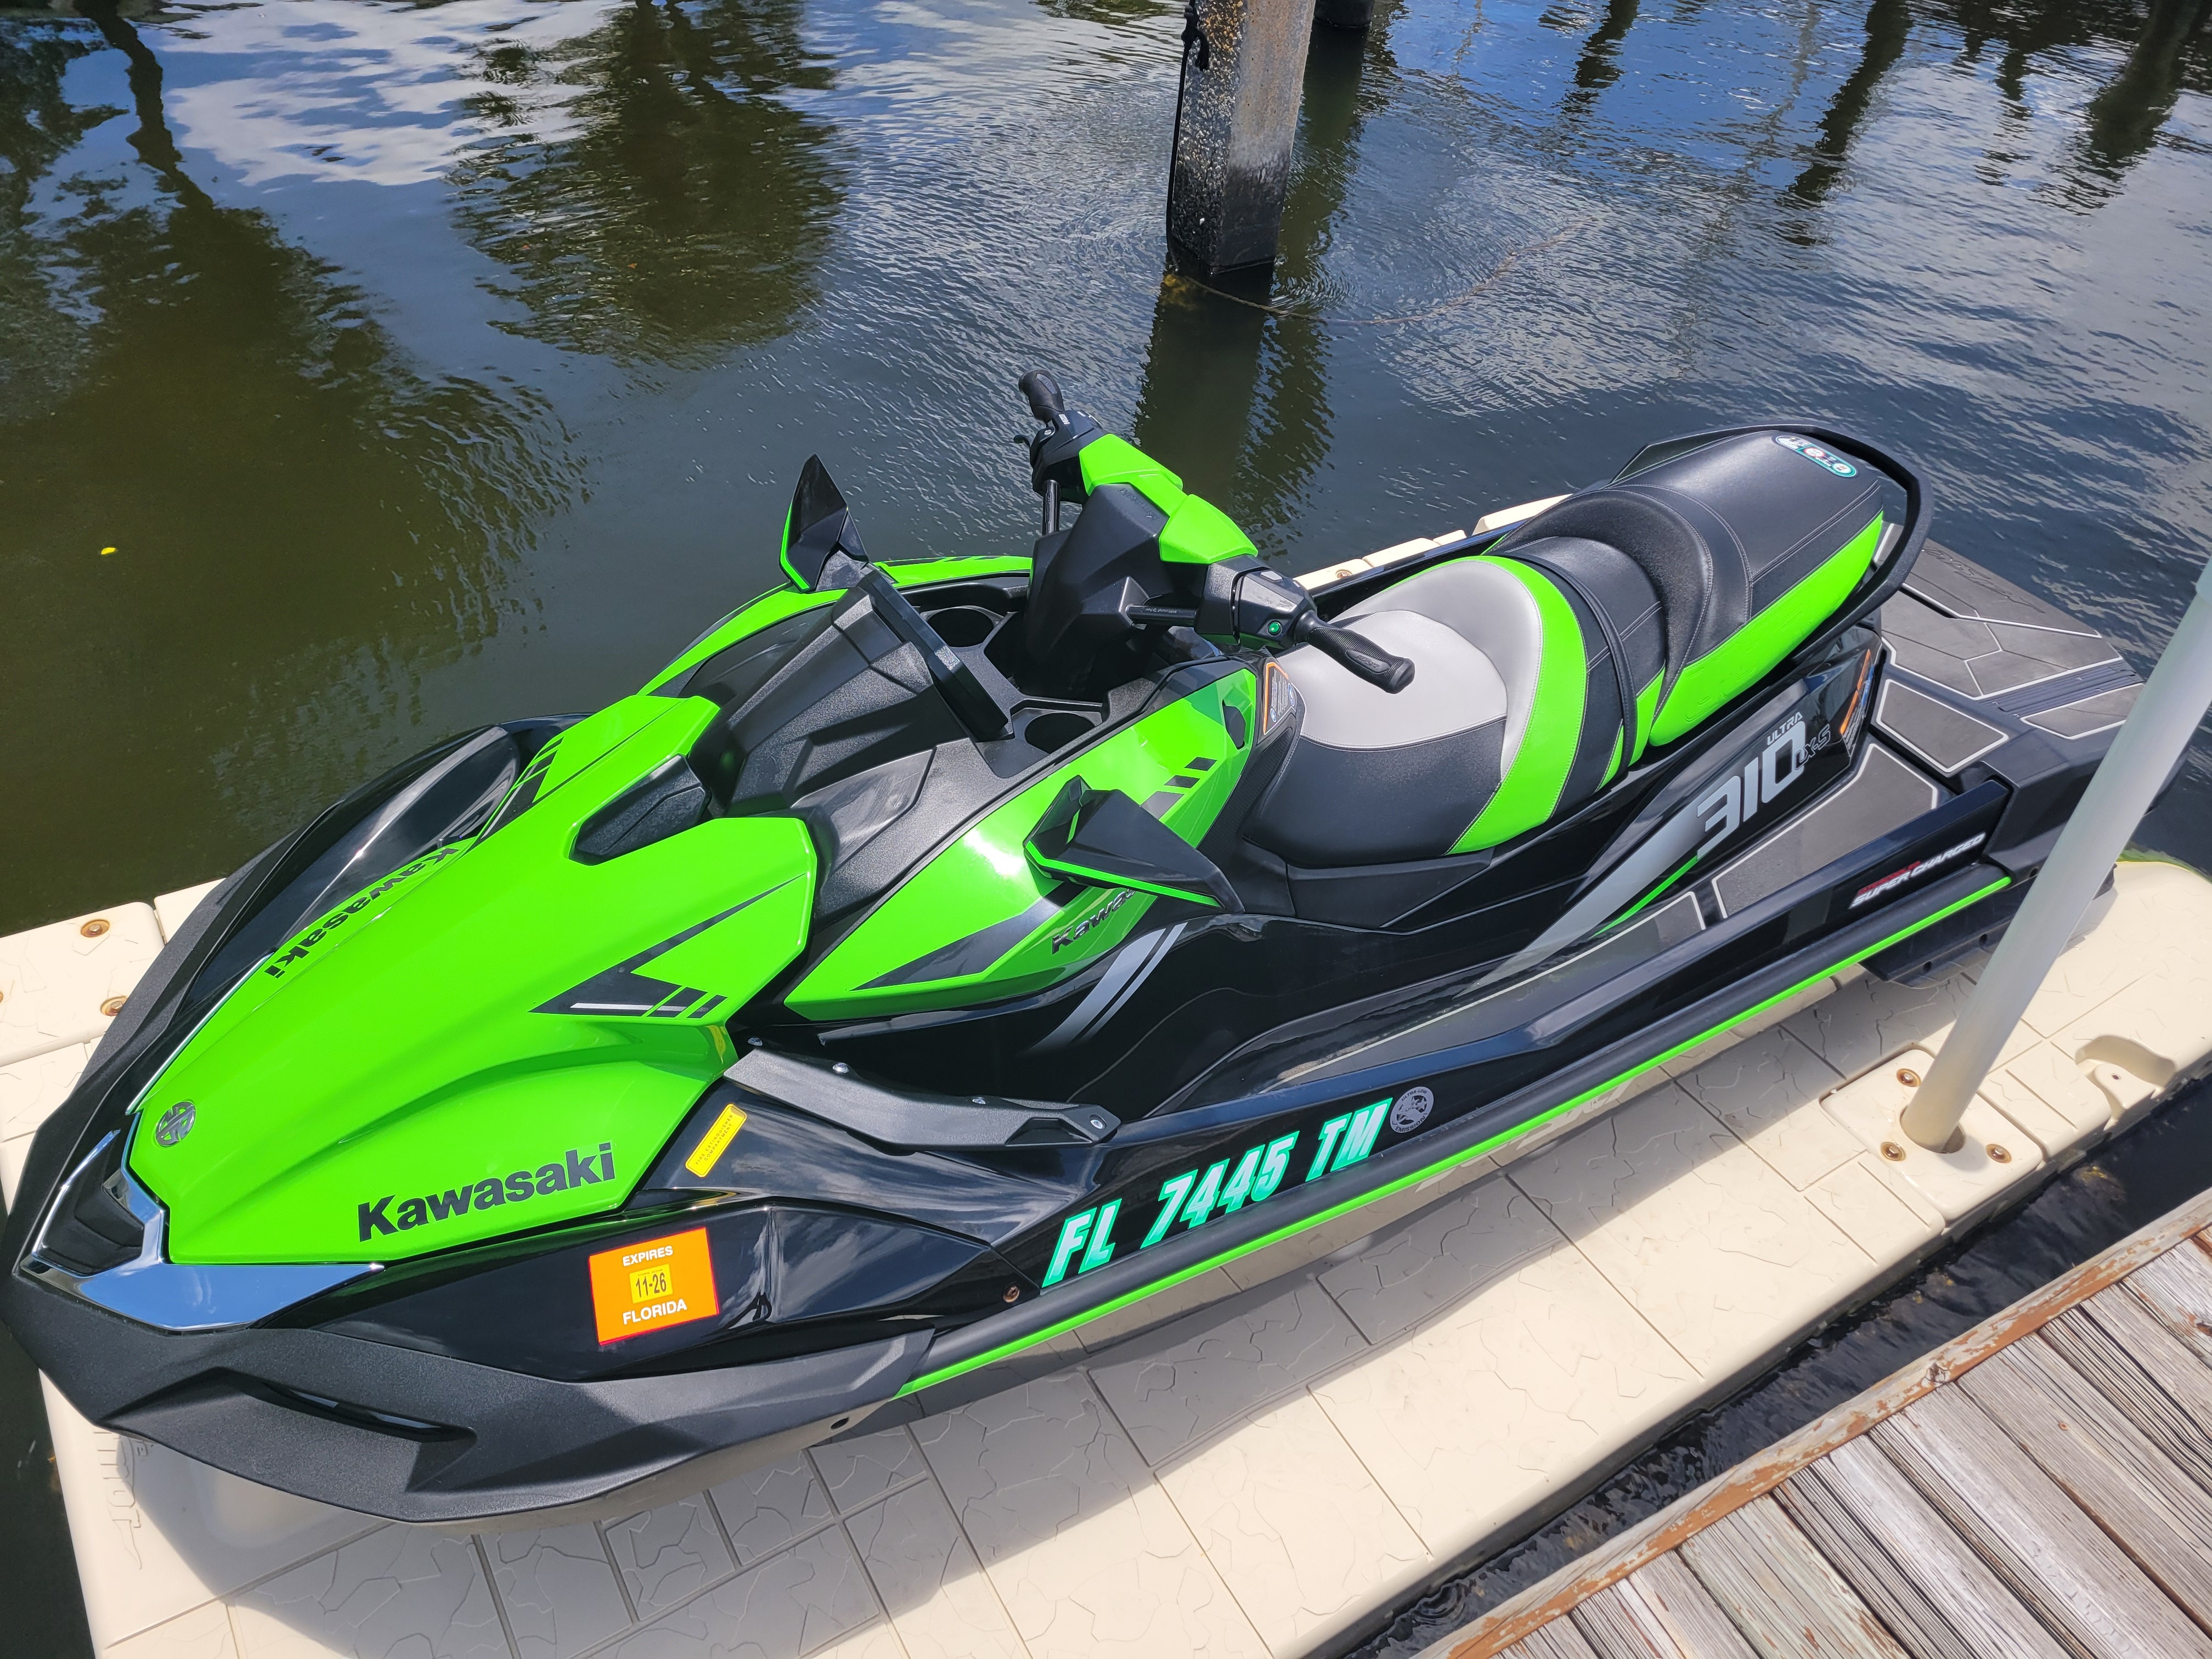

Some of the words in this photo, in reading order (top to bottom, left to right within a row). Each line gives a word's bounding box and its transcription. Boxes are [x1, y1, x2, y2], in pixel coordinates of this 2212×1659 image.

[1767, 712, 1803, 746] ULTRA
[1696, 720, 1807, 861] 310
[263, 847, 460, 979] Kawasaki
[696, 1153, 706, 1165] FIRE
[705, 1114, 733, 1152] EXTINGUISHER
[704, 1123, 732, 1161] COMPARTMENT
[1395, 1116, 1426, 1132] EMISSION
[357, 1141, 616, 1243] Kawasaki
[1042, 1198, 1122, 1288] FL
[1139, 1130, 1300, 1250] 7445
[1305, 1097, 1393, 1183] TM
[622, 1245, 673, 1267] EXPIRES
[635, 1272, 667, 1298] 11-26
[622, 1298, 687, 1325] FLORIDA
